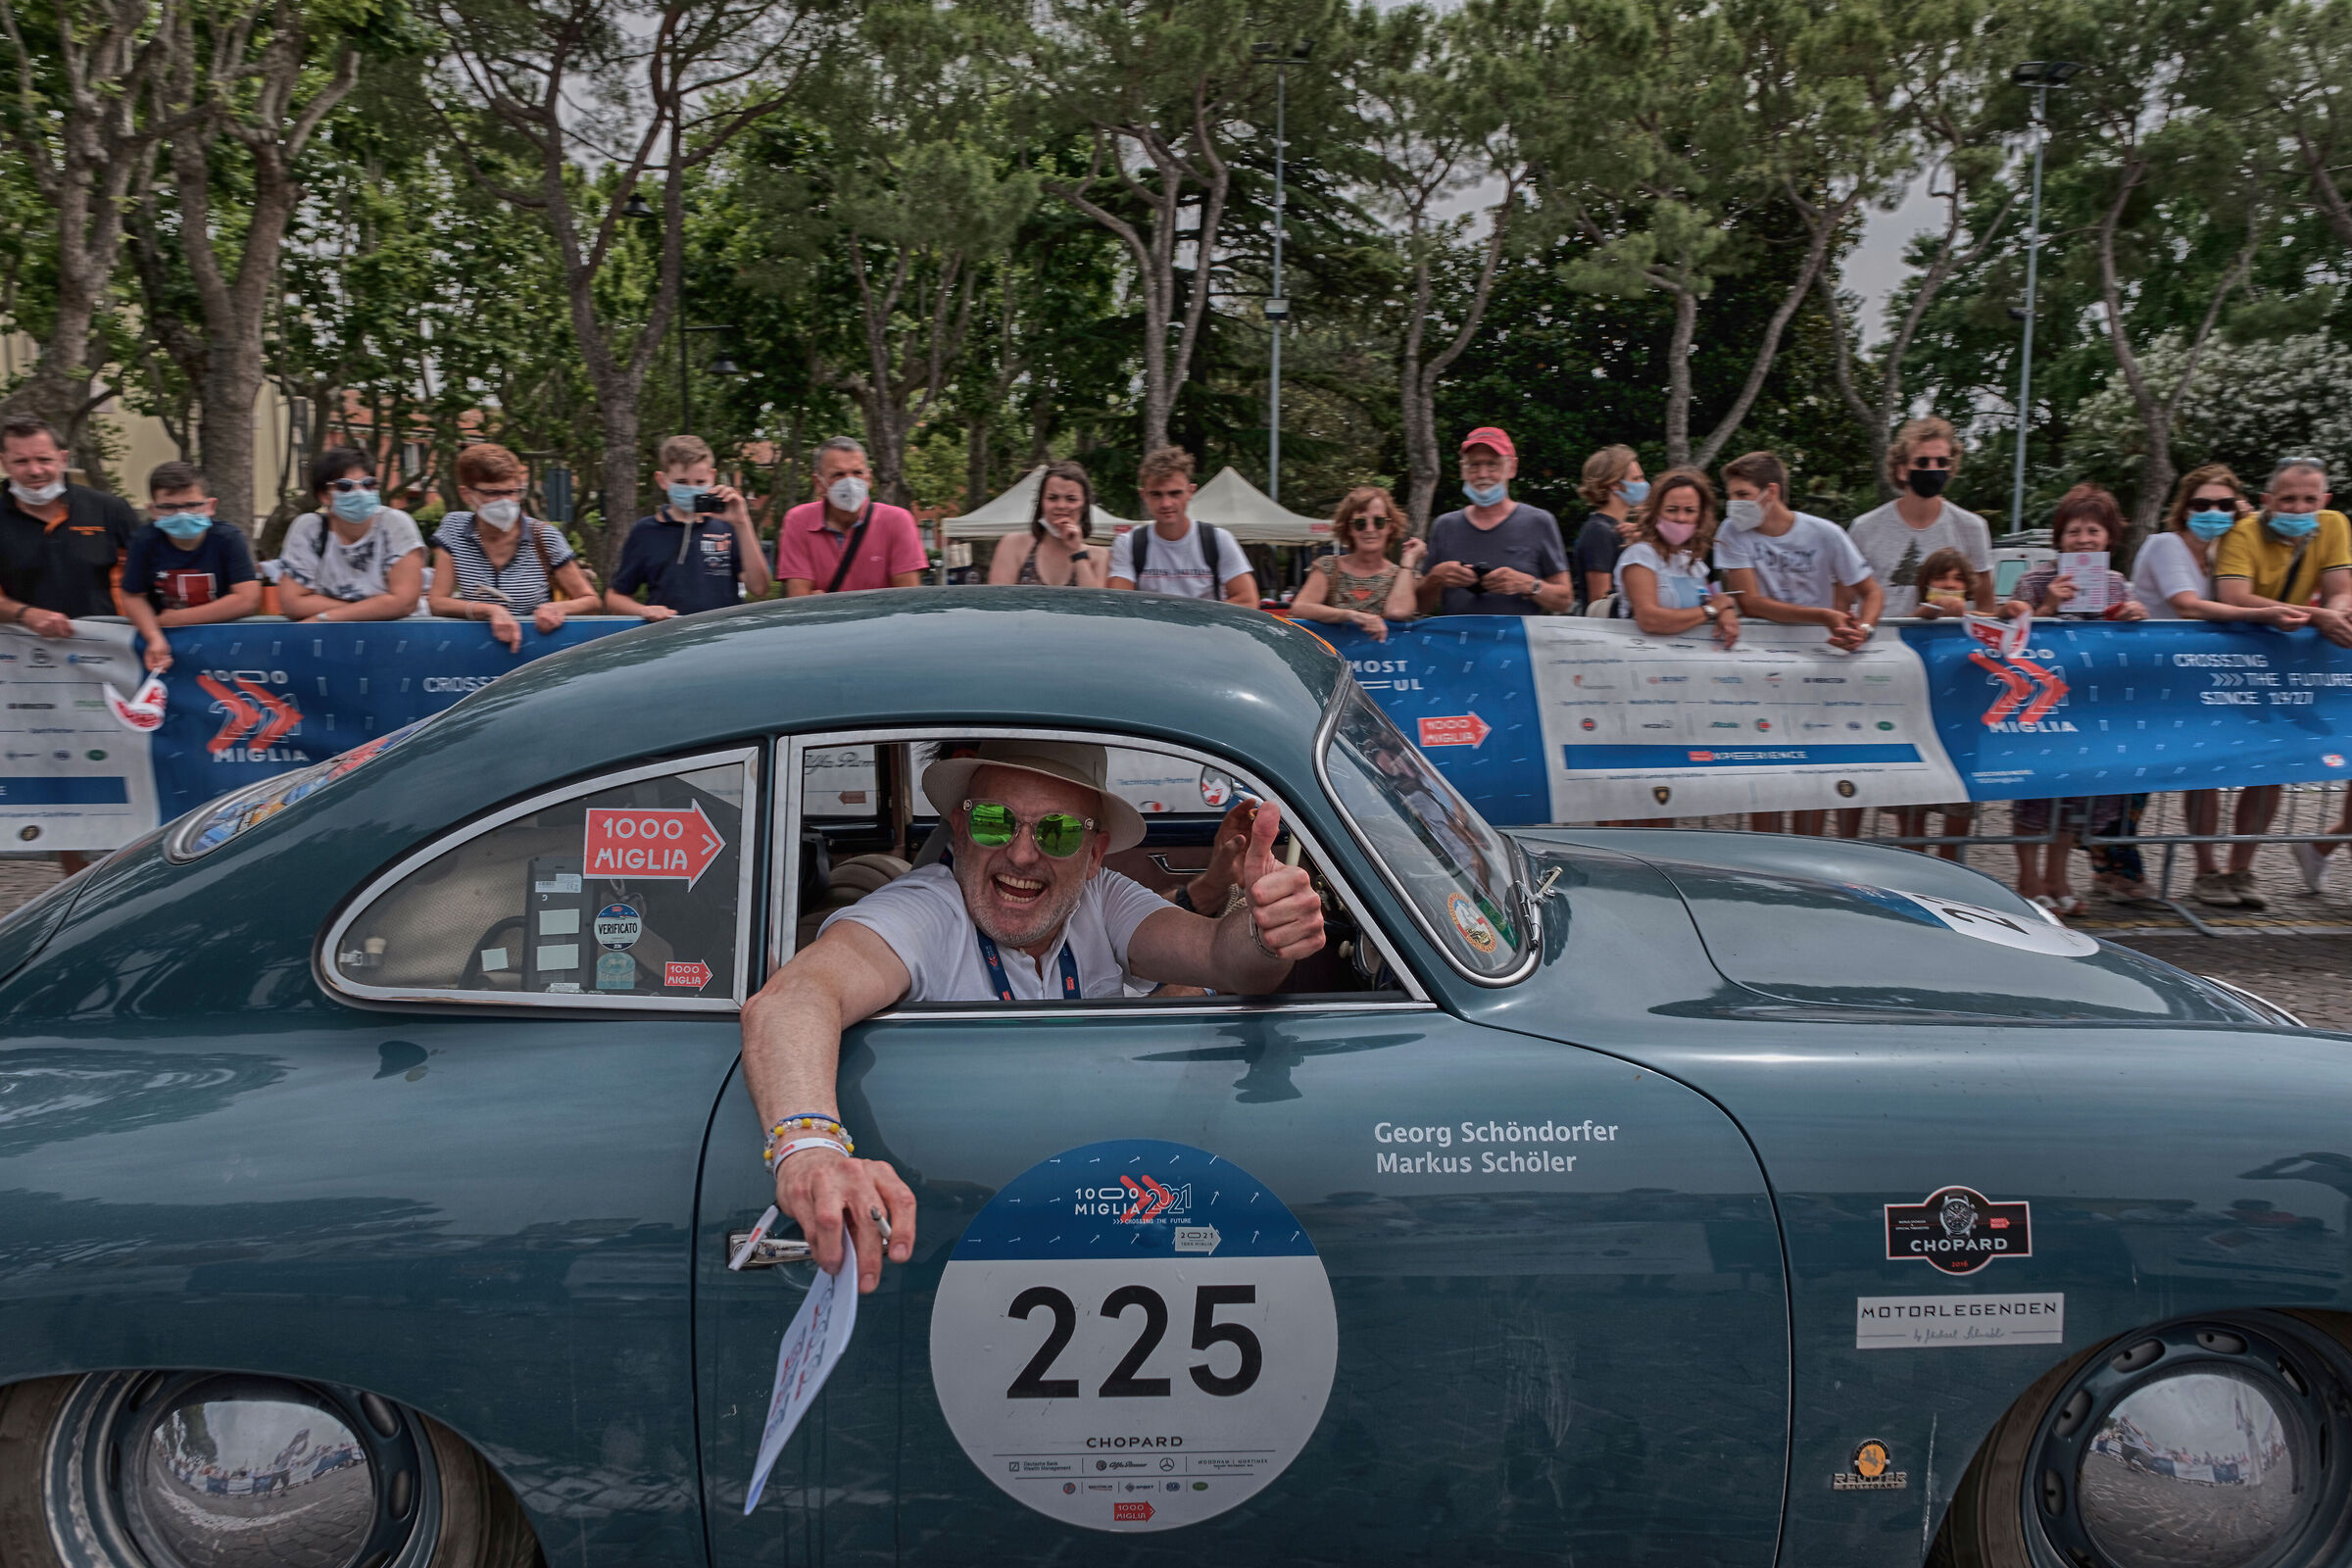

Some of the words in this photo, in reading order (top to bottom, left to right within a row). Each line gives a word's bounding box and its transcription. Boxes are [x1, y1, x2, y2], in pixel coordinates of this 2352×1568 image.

[422, 676, 502, 692] CROSS
[2242, 672, 2282, 686] THE
[2199, 691, 2262, 705] SINCE
[213, 748, 311, 762] MIGLIA
[603, 817, 684, 839] 1000
[594, 848, 687, 870] MIGLIA
[598, 923, 638, 935] VERIFICATO
[671, 965, 699, 974] 1000
[667, 975, 701, 985] MIGLIA
[1374, 1122, 1451, 1148] Georg
[1461, 1120, 1619, 1143] Schöndorfer
[1376, 1152, 1473, 1174] Markus
[1481, 1151, 1577, 1173] Schöler
[1074, 1187, 1140, 1200] 1000
[1145, 1183, 1192, 1214] 2021
[1074, 1202, 1141, 1215] MIGLIA
[1910, 1238, 2008, 1252] CHOPARD
[1861, 1301, 2057, 1318] MOTORLEGENDEN
[1006, 1284, 1263, 1399] 225
[1086, 1436, 1184, 1449] CHOPARD
